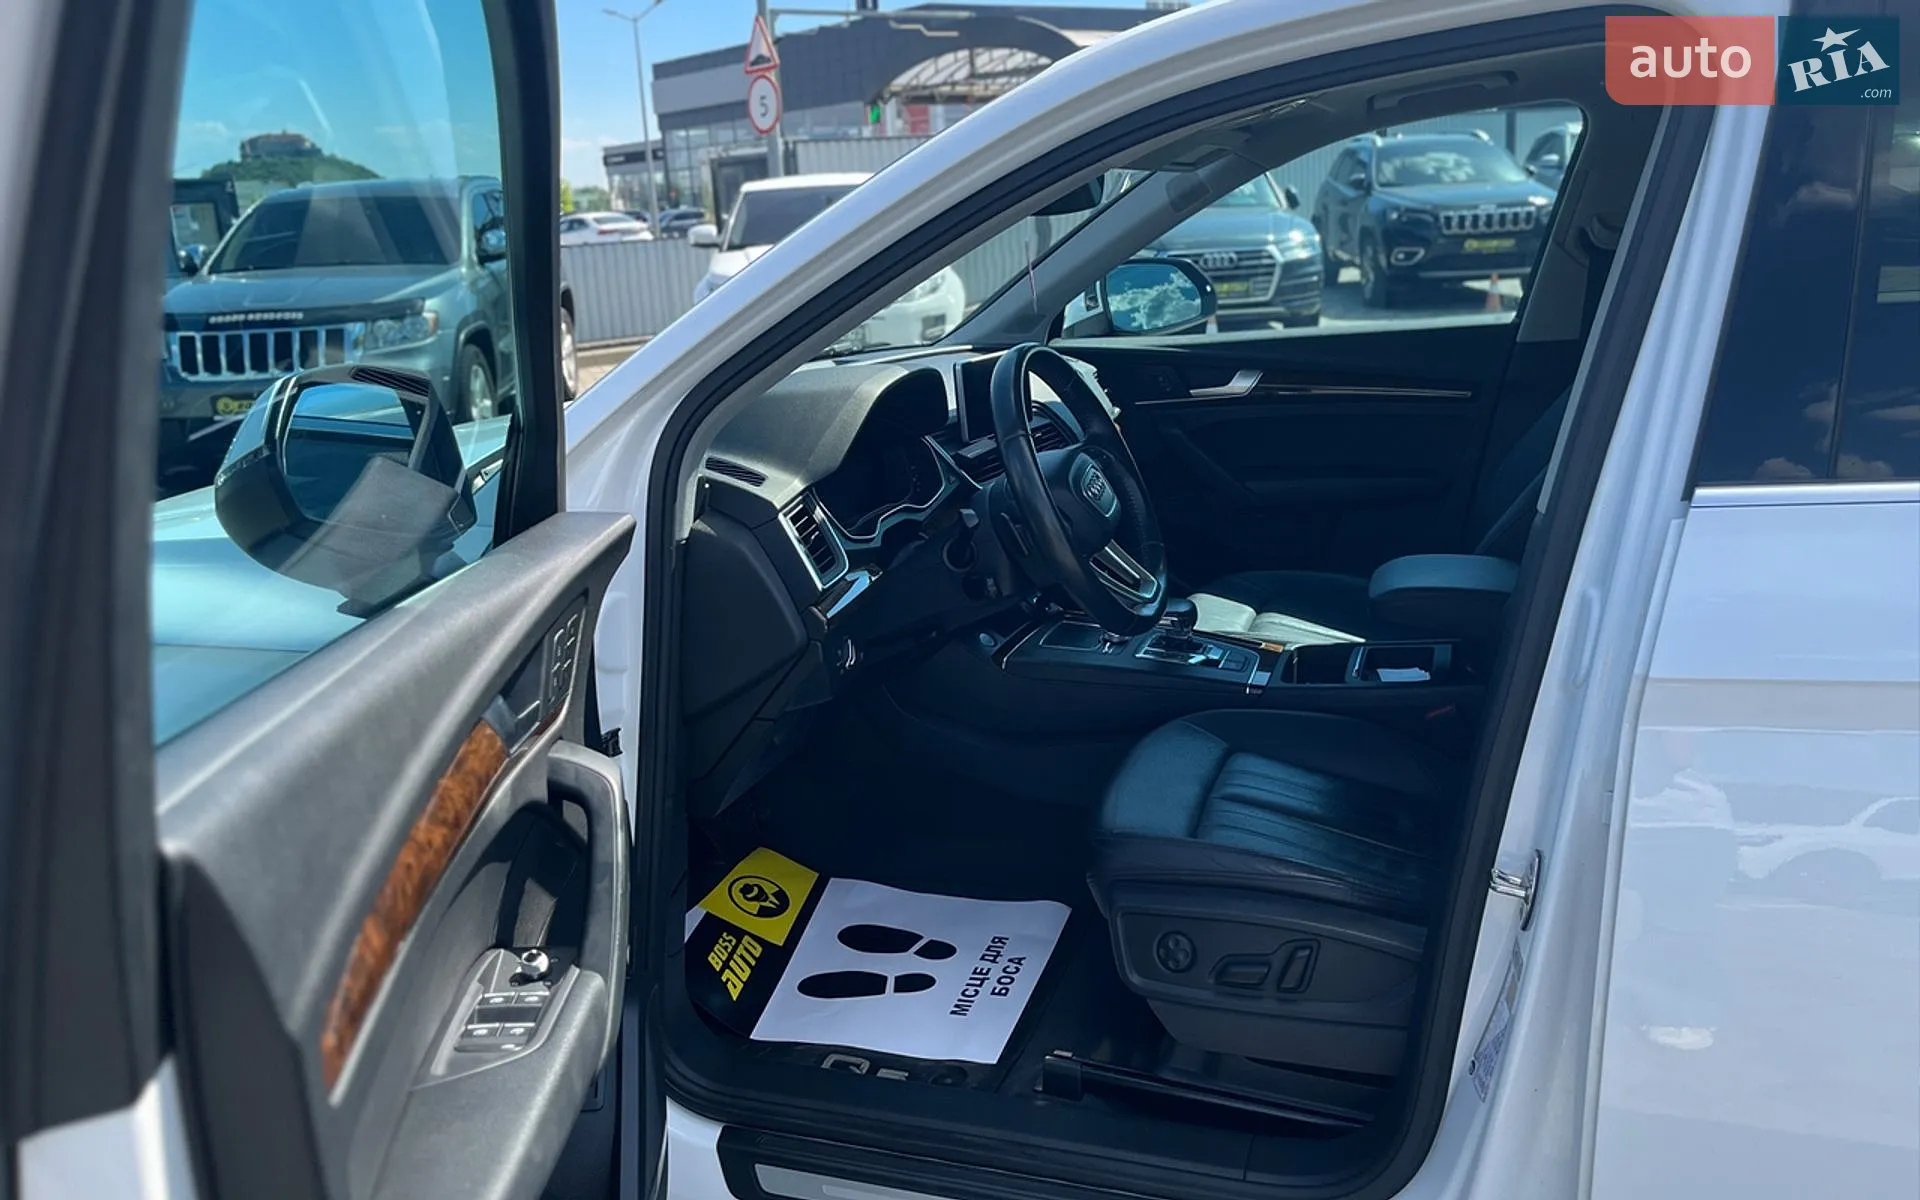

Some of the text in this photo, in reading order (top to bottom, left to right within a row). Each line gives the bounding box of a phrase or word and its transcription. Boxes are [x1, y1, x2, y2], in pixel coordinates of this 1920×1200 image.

[759, 94, 770, 119] 5
[708, 932, 737, 972] BOSS
[721, 935, 763, 1002] AUTO
[949, 936, 1010, 1017] МІСЦЕ ДЛЯ
[990, 956, 1027, 997] БОСА
